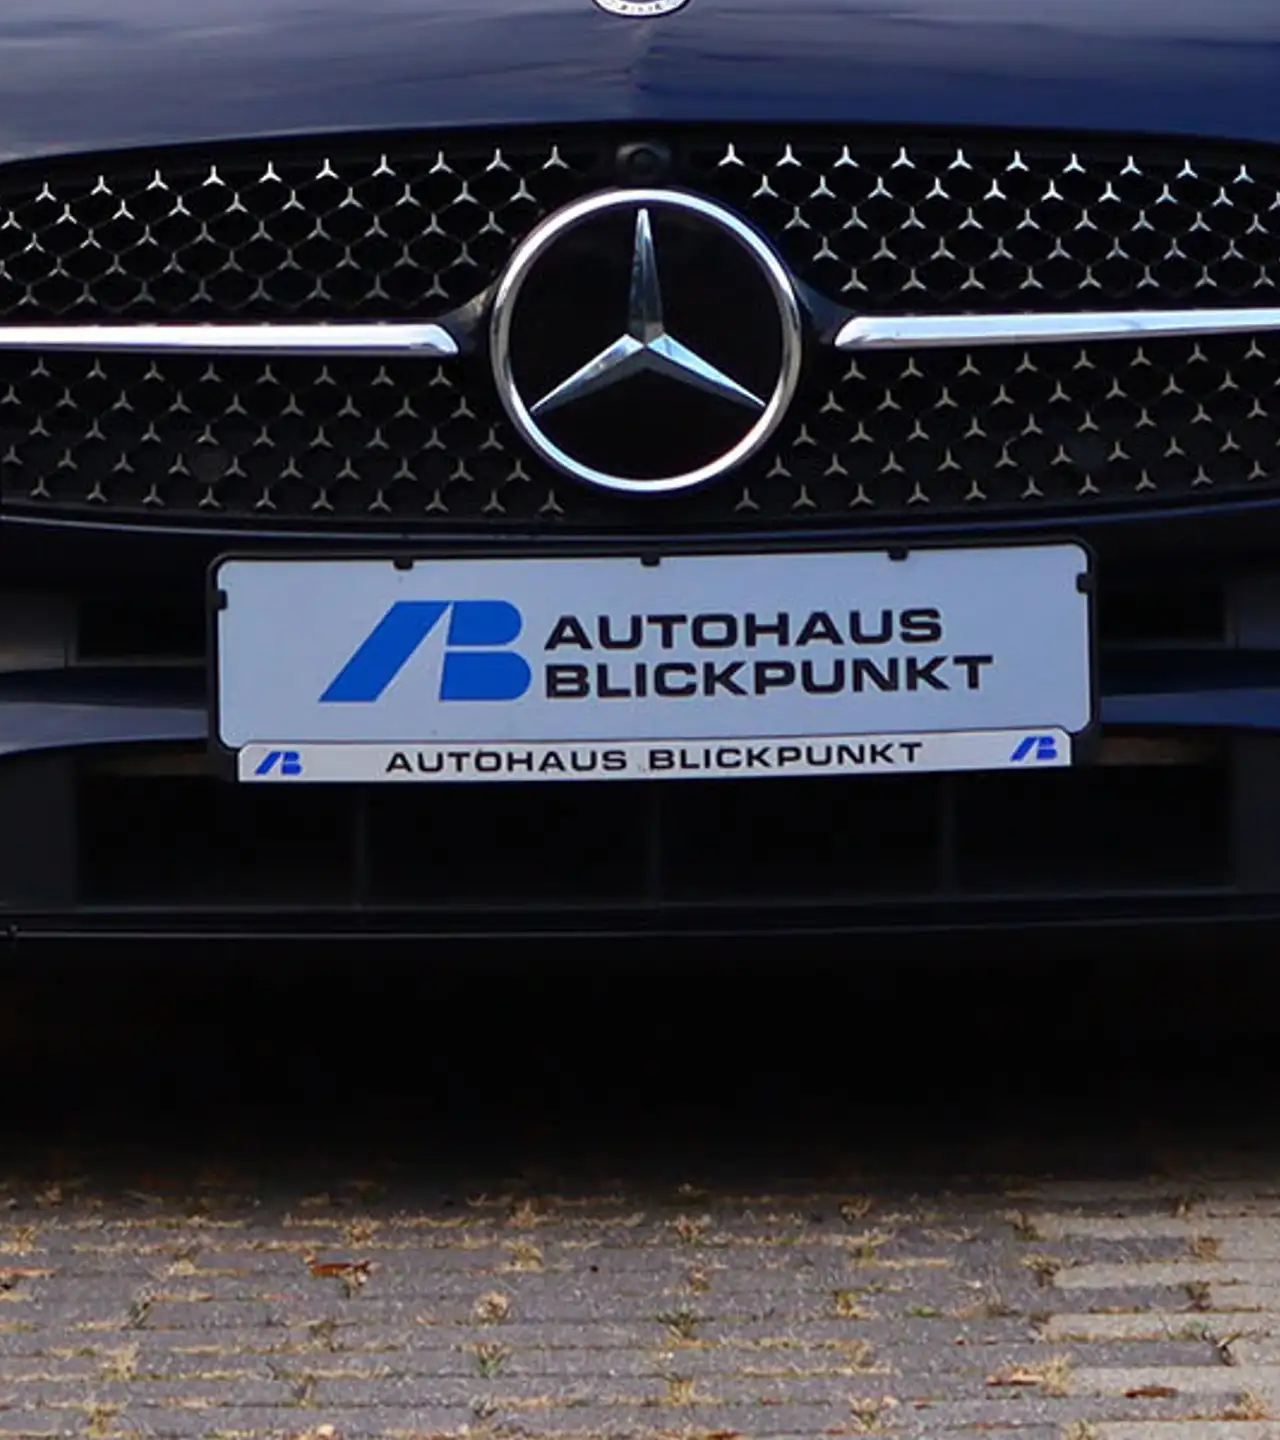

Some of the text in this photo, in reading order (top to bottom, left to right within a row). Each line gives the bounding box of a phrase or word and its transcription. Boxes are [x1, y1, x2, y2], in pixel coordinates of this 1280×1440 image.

[543, 607, 943, 652] AUTOHAUS
[544, 654, 994, 700] BLICKPUNKT
[385, 749, 628, 774] AUTOHAUS
[648, 741, 924, 771] BLICKPUNKT
